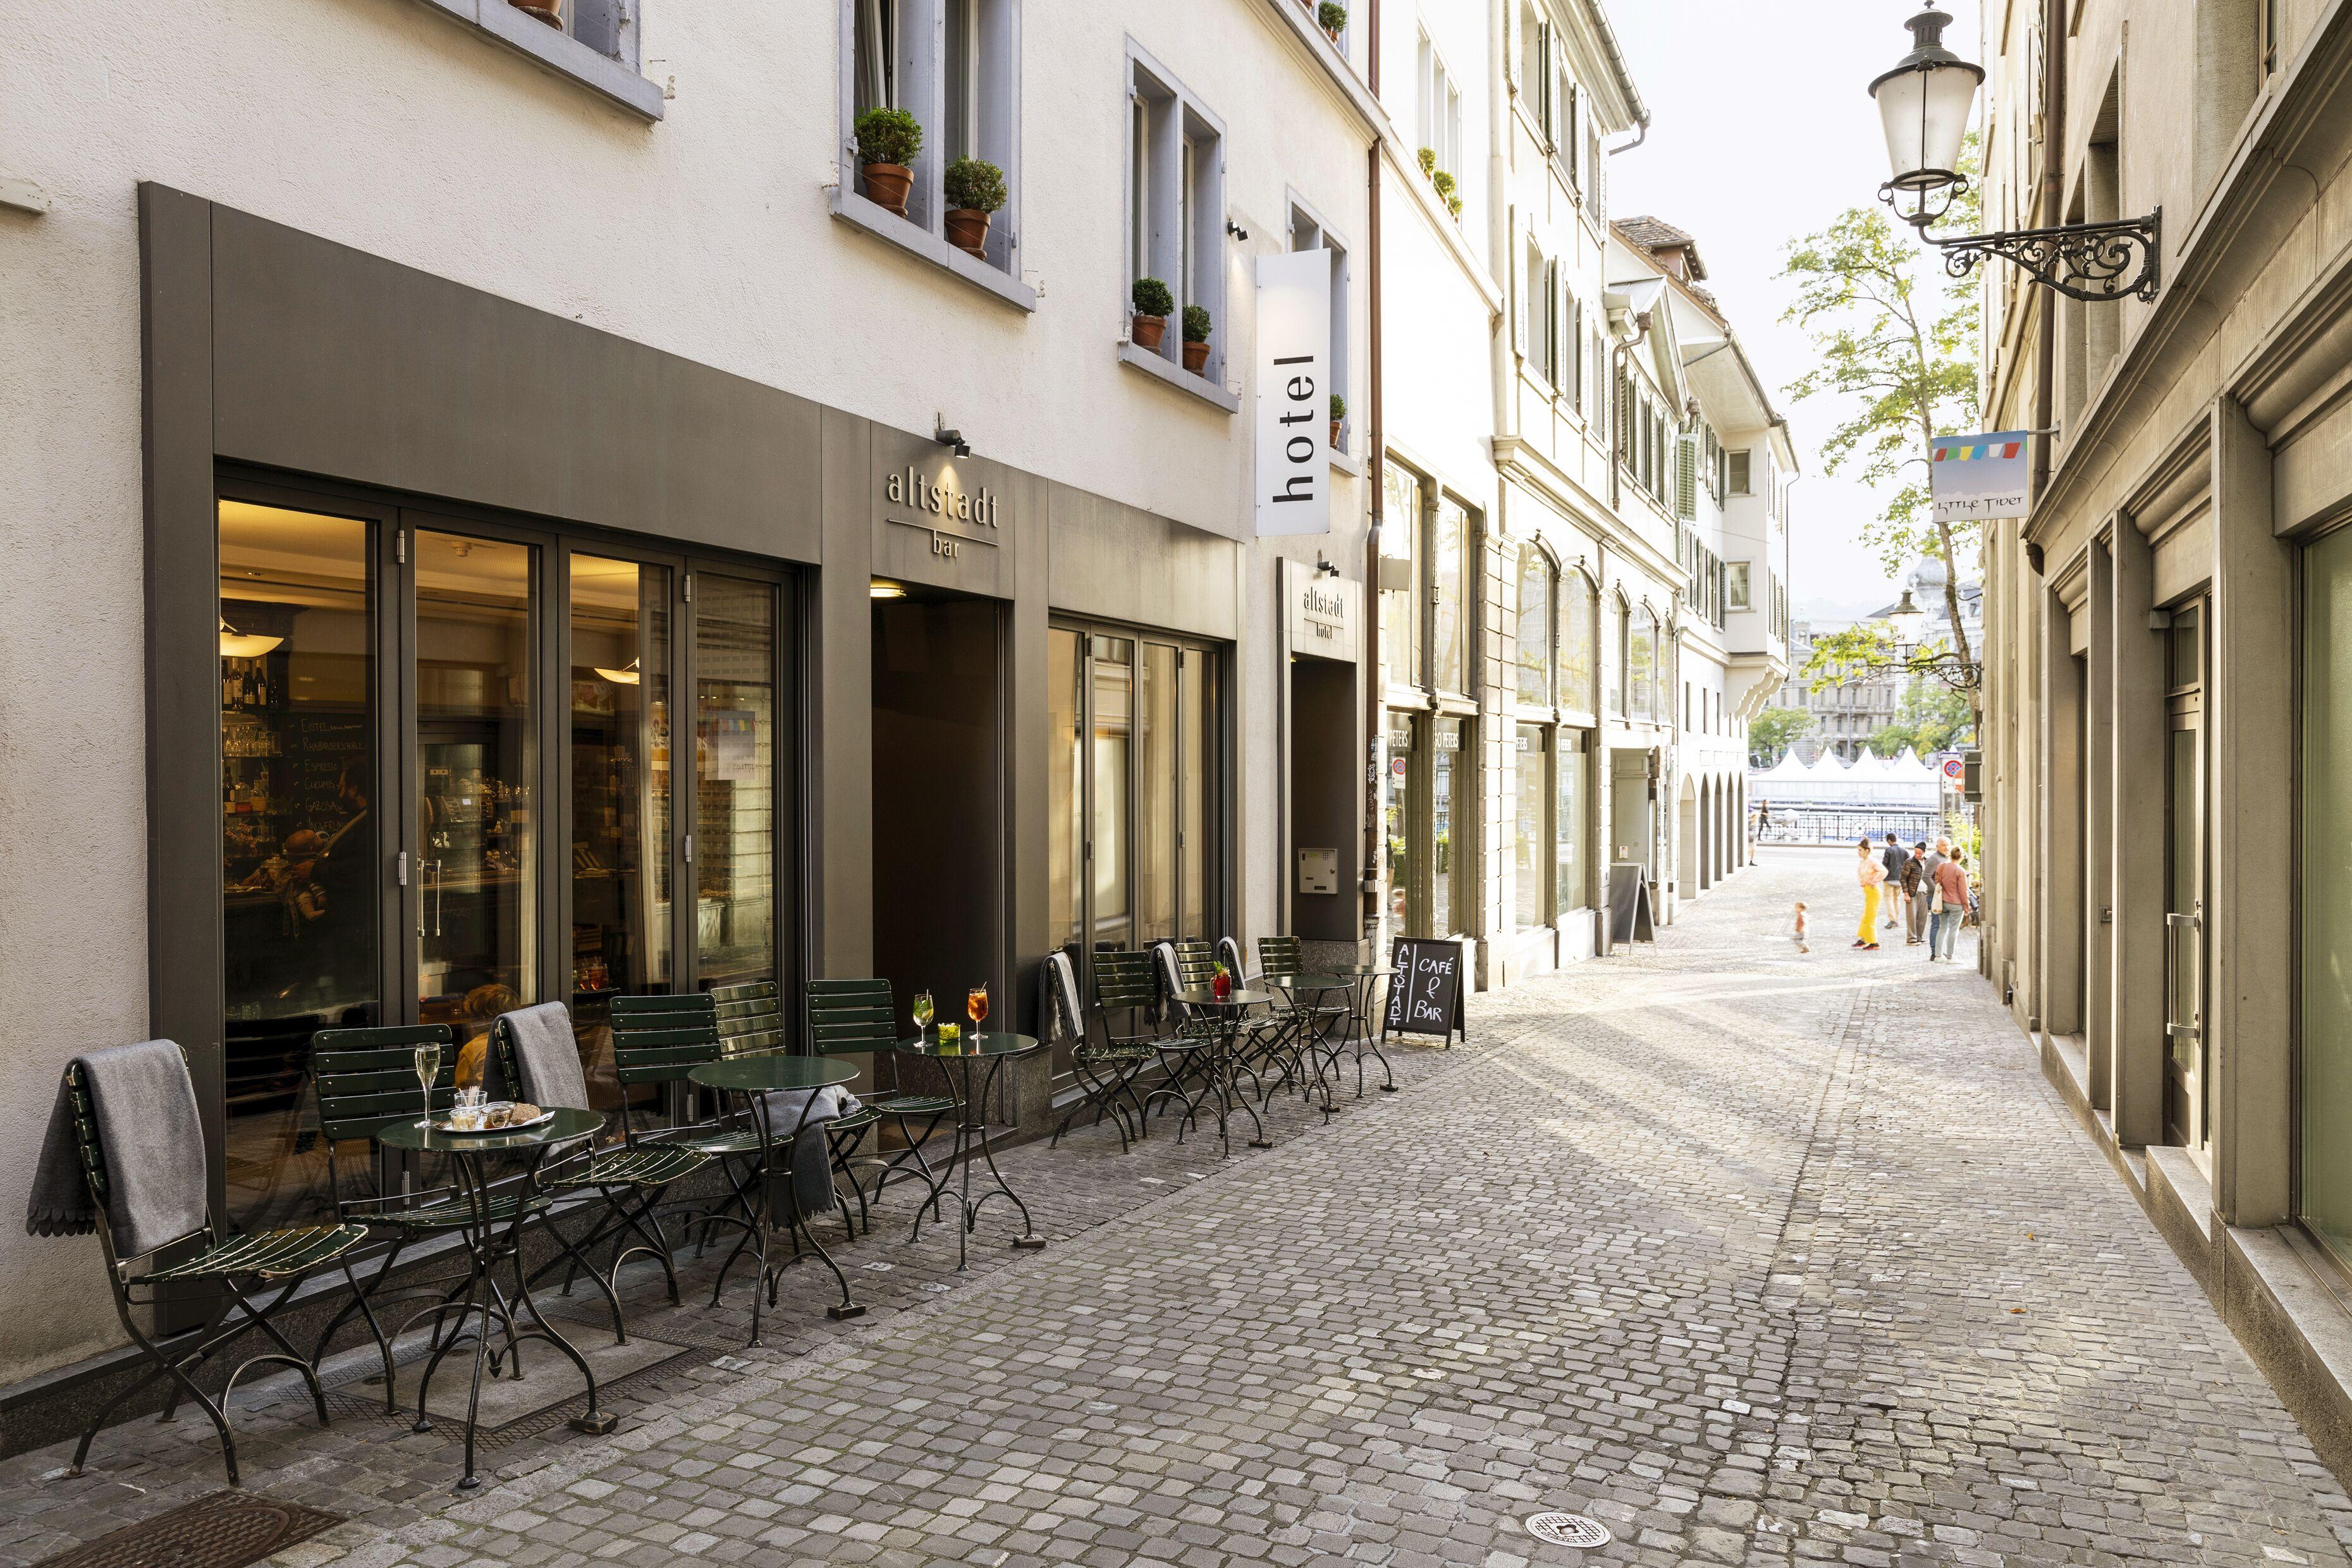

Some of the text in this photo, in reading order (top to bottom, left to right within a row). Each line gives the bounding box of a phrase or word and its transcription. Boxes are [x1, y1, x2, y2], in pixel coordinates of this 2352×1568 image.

[1273, 355, 1314, 503] hotel
[888, 465, 998, 529] altstadt
[932, 529, 960, 559] bar
[1304, 587, 1344, 618] altstadt
[1316, 622, 1333, 639] hotel
[1389, 729, 1408, 747] PETERS
[1443, 732, 1459, 748] PETERS
[304, 759, 338, 772] ESPRESSO
[1418, 957, 1454, 975] CAFÉ
[1389, 943, 1409, 1026] ALTSTADT
[1414, 1000, 1442, 1022] BAR
